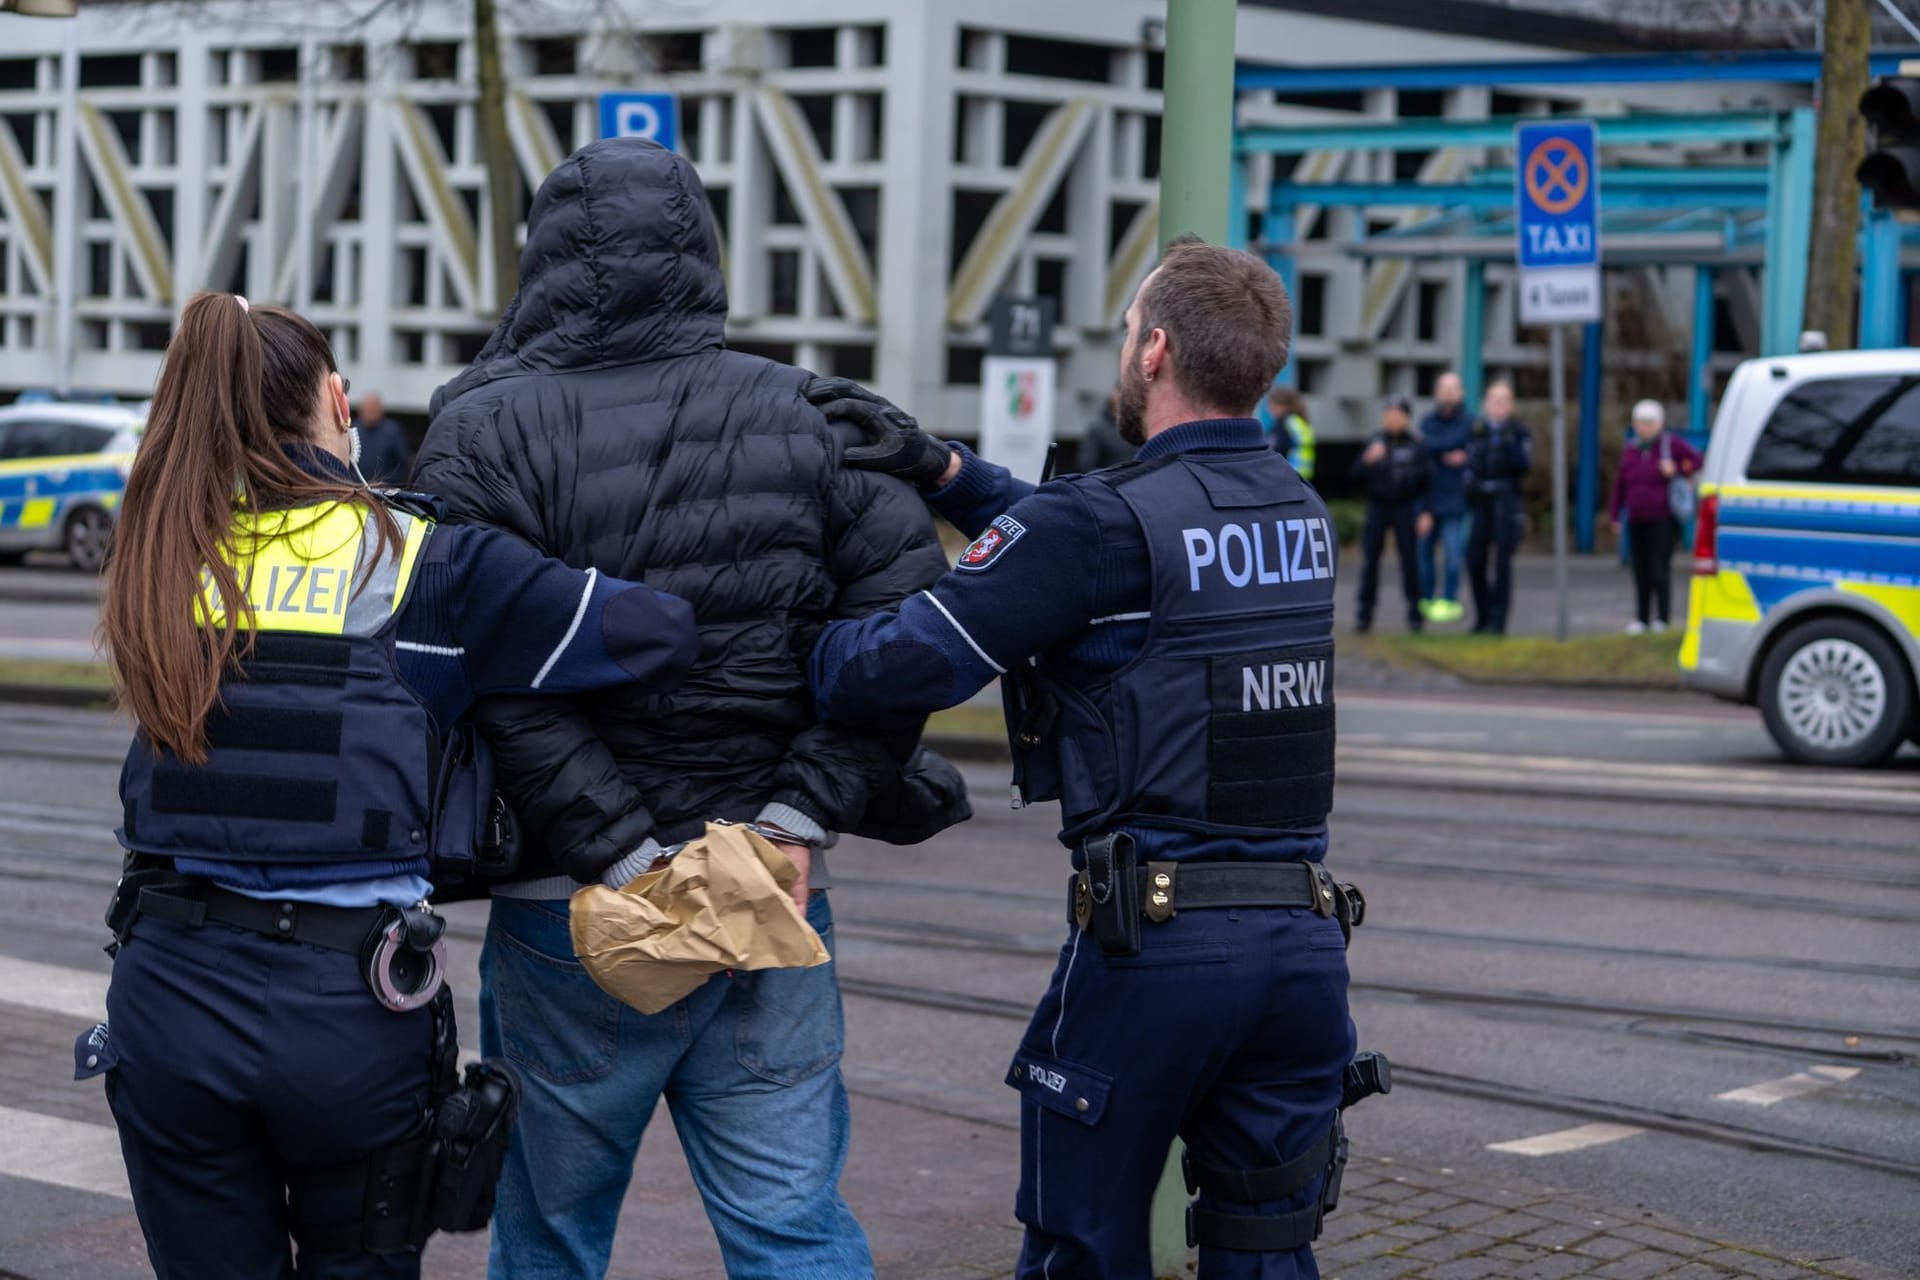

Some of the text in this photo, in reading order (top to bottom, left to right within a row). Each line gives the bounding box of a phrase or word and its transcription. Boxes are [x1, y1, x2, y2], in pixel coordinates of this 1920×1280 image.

[616, 102, 660, 139] P
[1527, 223, 1592, 254] TAXI
[1182, 517, 1334, 592] POLIZEI
[1242, 659, 1325, 712] NRW
